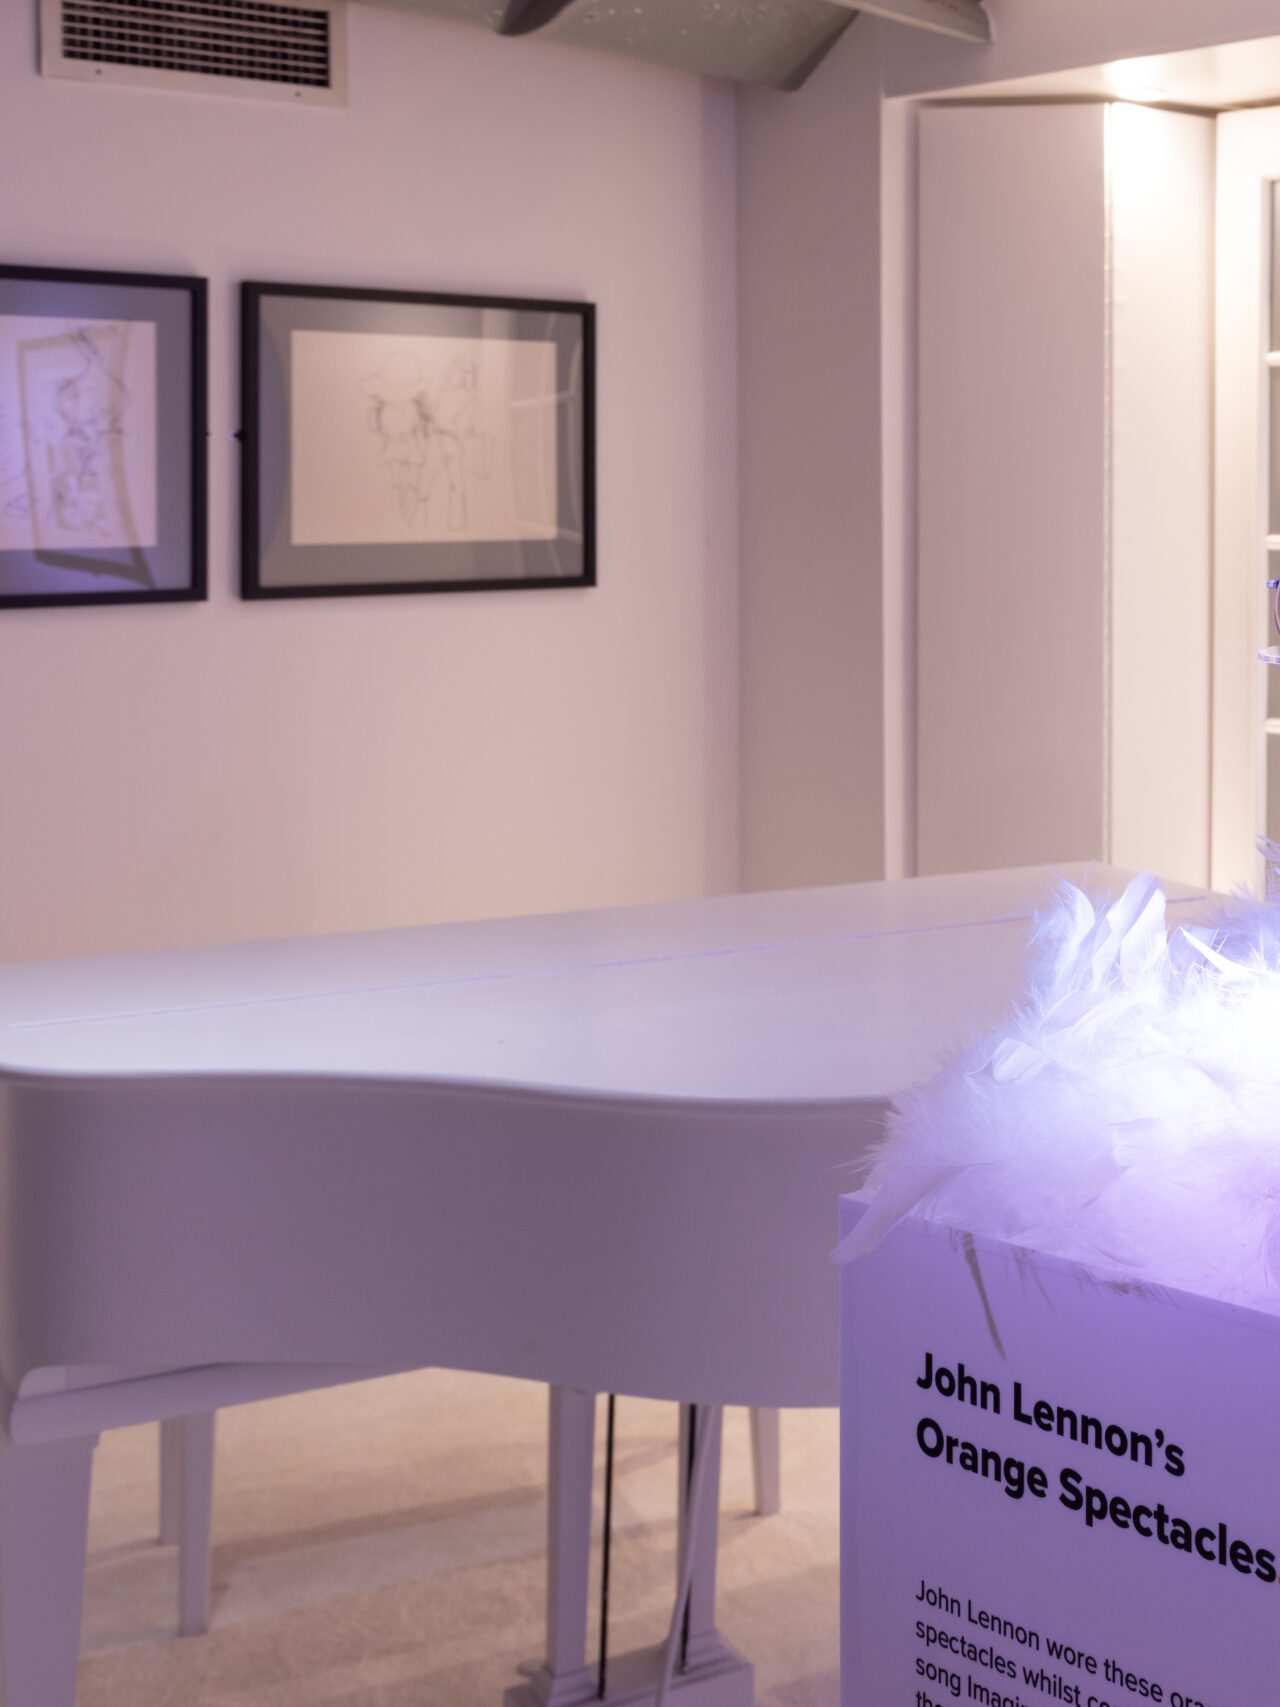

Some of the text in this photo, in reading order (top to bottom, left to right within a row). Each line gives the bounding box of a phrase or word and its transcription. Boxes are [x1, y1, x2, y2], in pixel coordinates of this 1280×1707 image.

[915, 1351, 1186, 1478] John Lennon’s
[915, 1416, 1049, 1501] Orange
[915, 1579, 961, 1618] John
[967, 1599, 1040, 1652] Lennon
[1045, 1637, 1098, 1676] wore
[1103, 1658, 1164, 1704] these
[915, 1620, 1082, 1707] spectacles whilst
[915, 1657, 962, 1698] song
